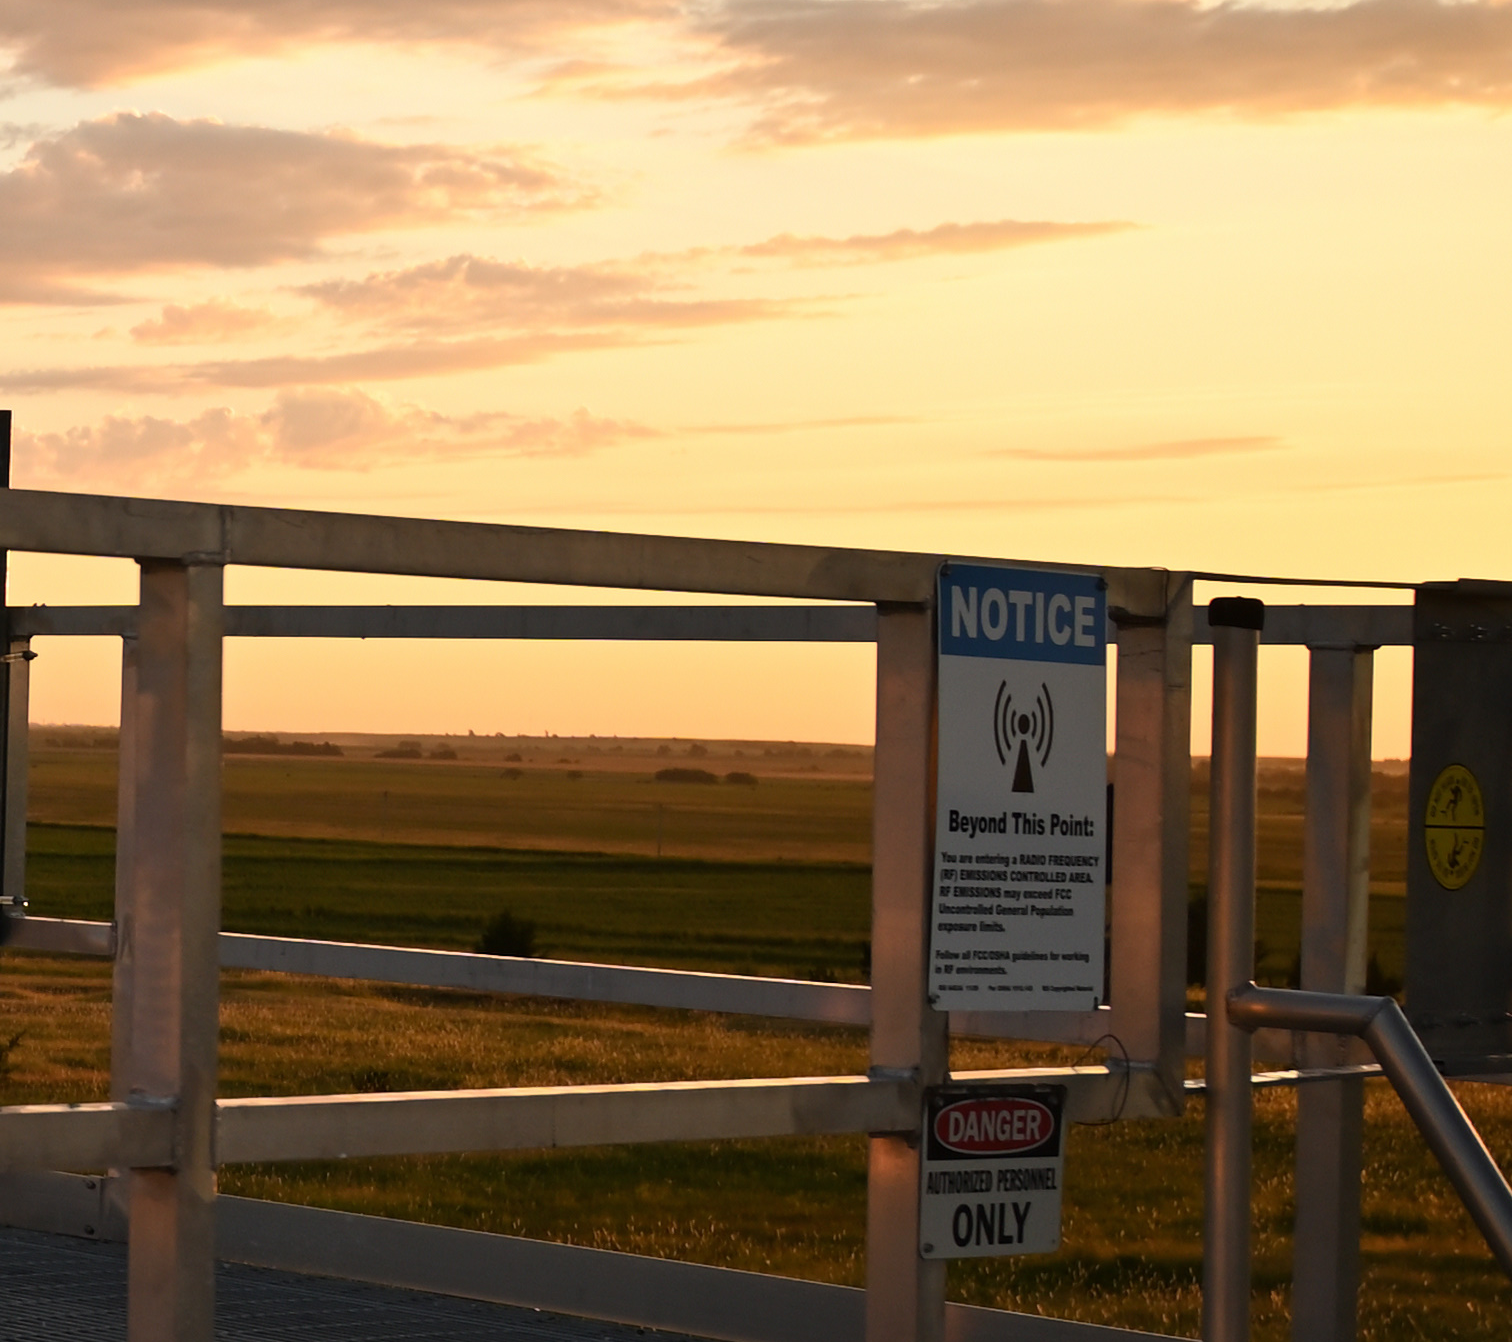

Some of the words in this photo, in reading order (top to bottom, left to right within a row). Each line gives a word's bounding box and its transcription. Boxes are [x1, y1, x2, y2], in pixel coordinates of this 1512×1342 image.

[950, 584, 1096, 648] NOTICE
[949, 810, 1006, 838] Beyond
[1012, 812, 1045, 835] This
[1050, 814, 1094, 837] Point:
[941, 853, 956, 863] You
[959, 855, 973, 864] are
[976, 854, 1009, 867] entering
[1020, 855, 1046, 865] RADIO
[1048, 855, 1099, 867] FREQUENCY
[940, 869, 957, 882] (RF)
[960, 870, 1007, 881] EMISSIONS
[1010, 871, 1066, 882] CONTROLLED
[1069, 872, 1093, 883] AREA.
[940, 886, 951, 897] RF
[954, 887, 1001, 898] EMISSIONS
[1004, 890, 1021, 901] may
[1023, 889, 1052, 899] exceed
[1055, 889, 1072, 899] FCC
[939, 903, 993, 915] Uncontrolled
[996, 905, 1028, 915] General
[1031, 906, 1073, 918] Population
[938, 923, 977, 933] exposure
[980, 921, 1005, 932] limits.
[936, 950, 959, 960] Follow
[962, 950, 970, 960] all
[1012, 951, 1047, 962] guidelines
[1050, 952, 1059, 960] for
[1062, 952, 1089, 963] working
[944, 965, 953, 974] RF
[948, 1110, 1042, 1142] DANGER
[927, 1170, 992, 1194] AUTHORIZED
[997, 1168, 1057, 1192] PERSONNEL
[953, 1202, 1031, 1247] ONLY
